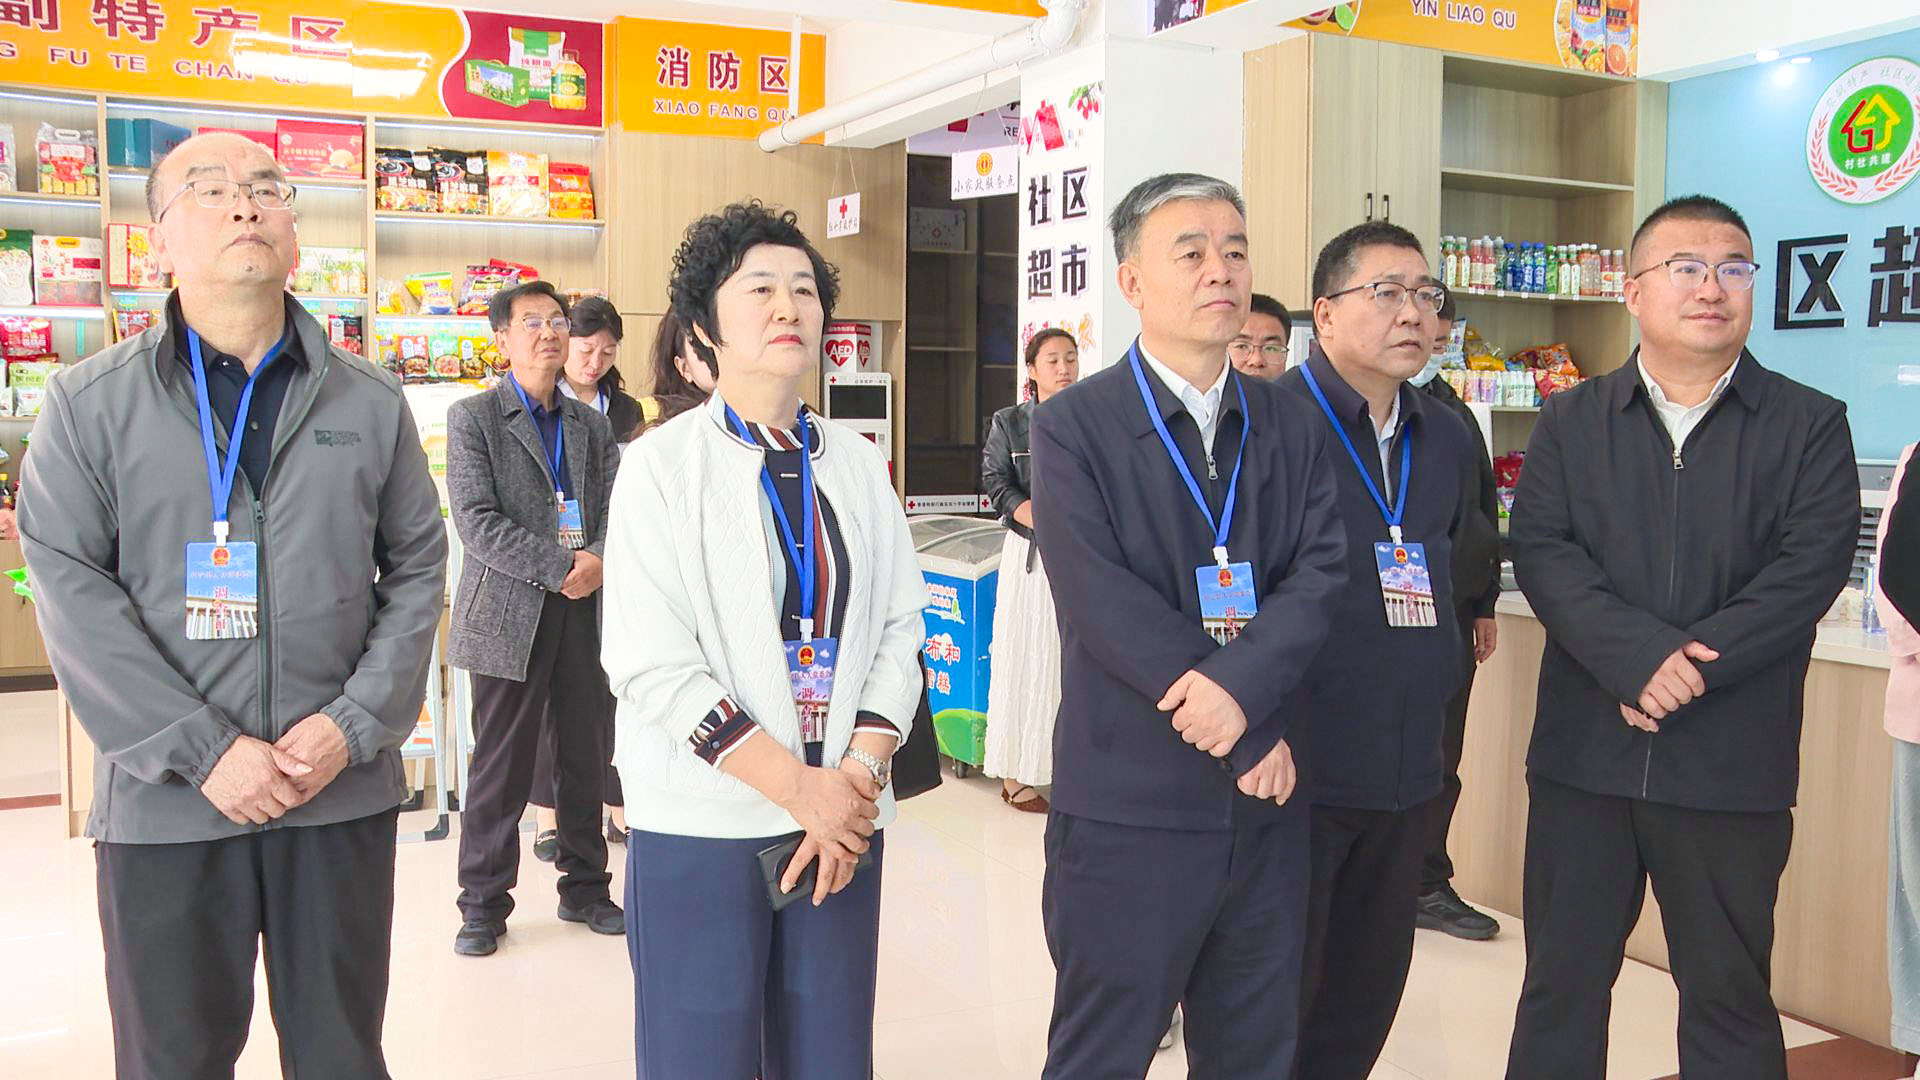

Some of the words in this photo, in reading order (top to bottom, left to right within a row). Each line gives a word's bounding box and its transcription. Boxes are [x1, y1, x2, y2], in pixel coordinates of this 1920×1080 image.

[1412, 0, 1437, 16] YIN
[1447, 7, 1484, 23] LIAO
[1493, 11, 1516, 28] QU
[49, 48, 88, 65] FU
[109, 54, 146, 71] TE
[175, 60, 253, 80] CHAN
[657, 47, 789, 93] 消防区
[655, 100, 700, 115] XIAO
[709, 104, 758, 119] FANG
[1028, 166, 1088, 226] 社区
[1028, 243, 1088, 300] 超市
[829, 343, 852, 358] AED
